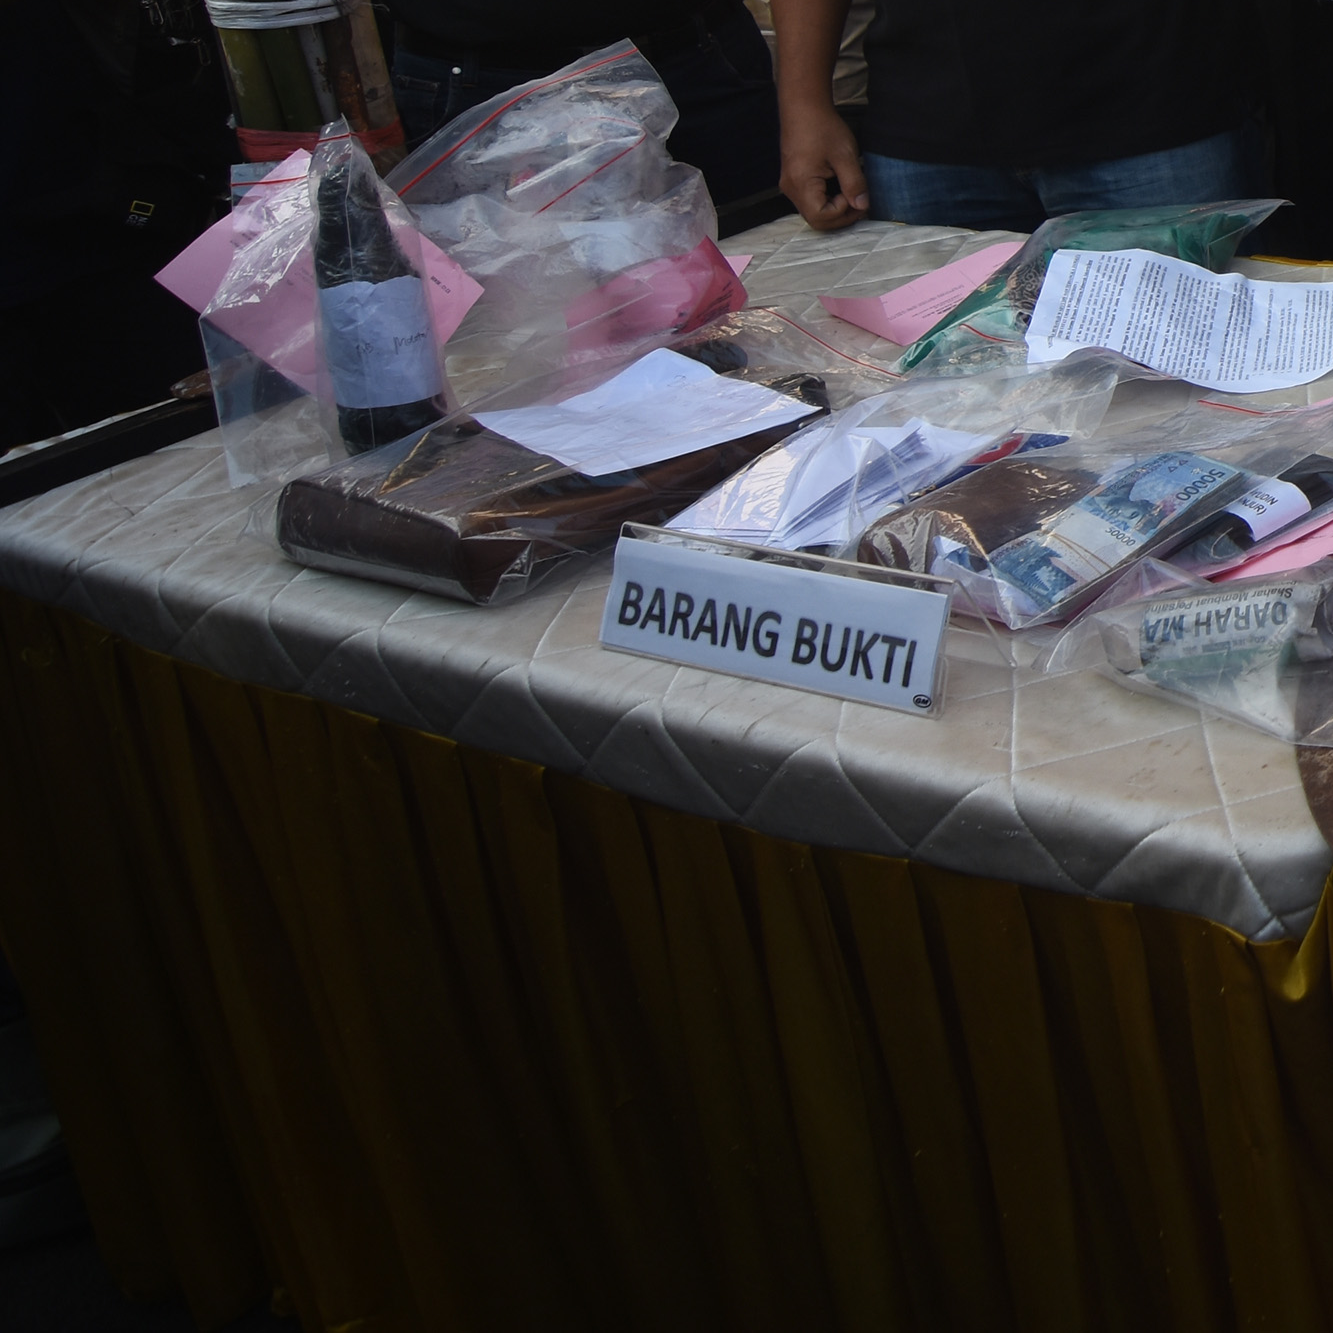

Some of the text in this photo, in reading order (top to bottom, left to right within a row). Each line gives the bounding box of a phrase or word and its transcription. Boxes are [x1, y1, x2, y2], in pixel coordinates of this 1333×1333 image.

[1175, 468, 1226, 501] 50000
[1251, 490, 1279, 506] YUDIN
[1104, 526, 1136, 547] 50000
[618, 581, 918, 689] BARANG BUKTI
[1194, 601, 1288, 637] DARAH
